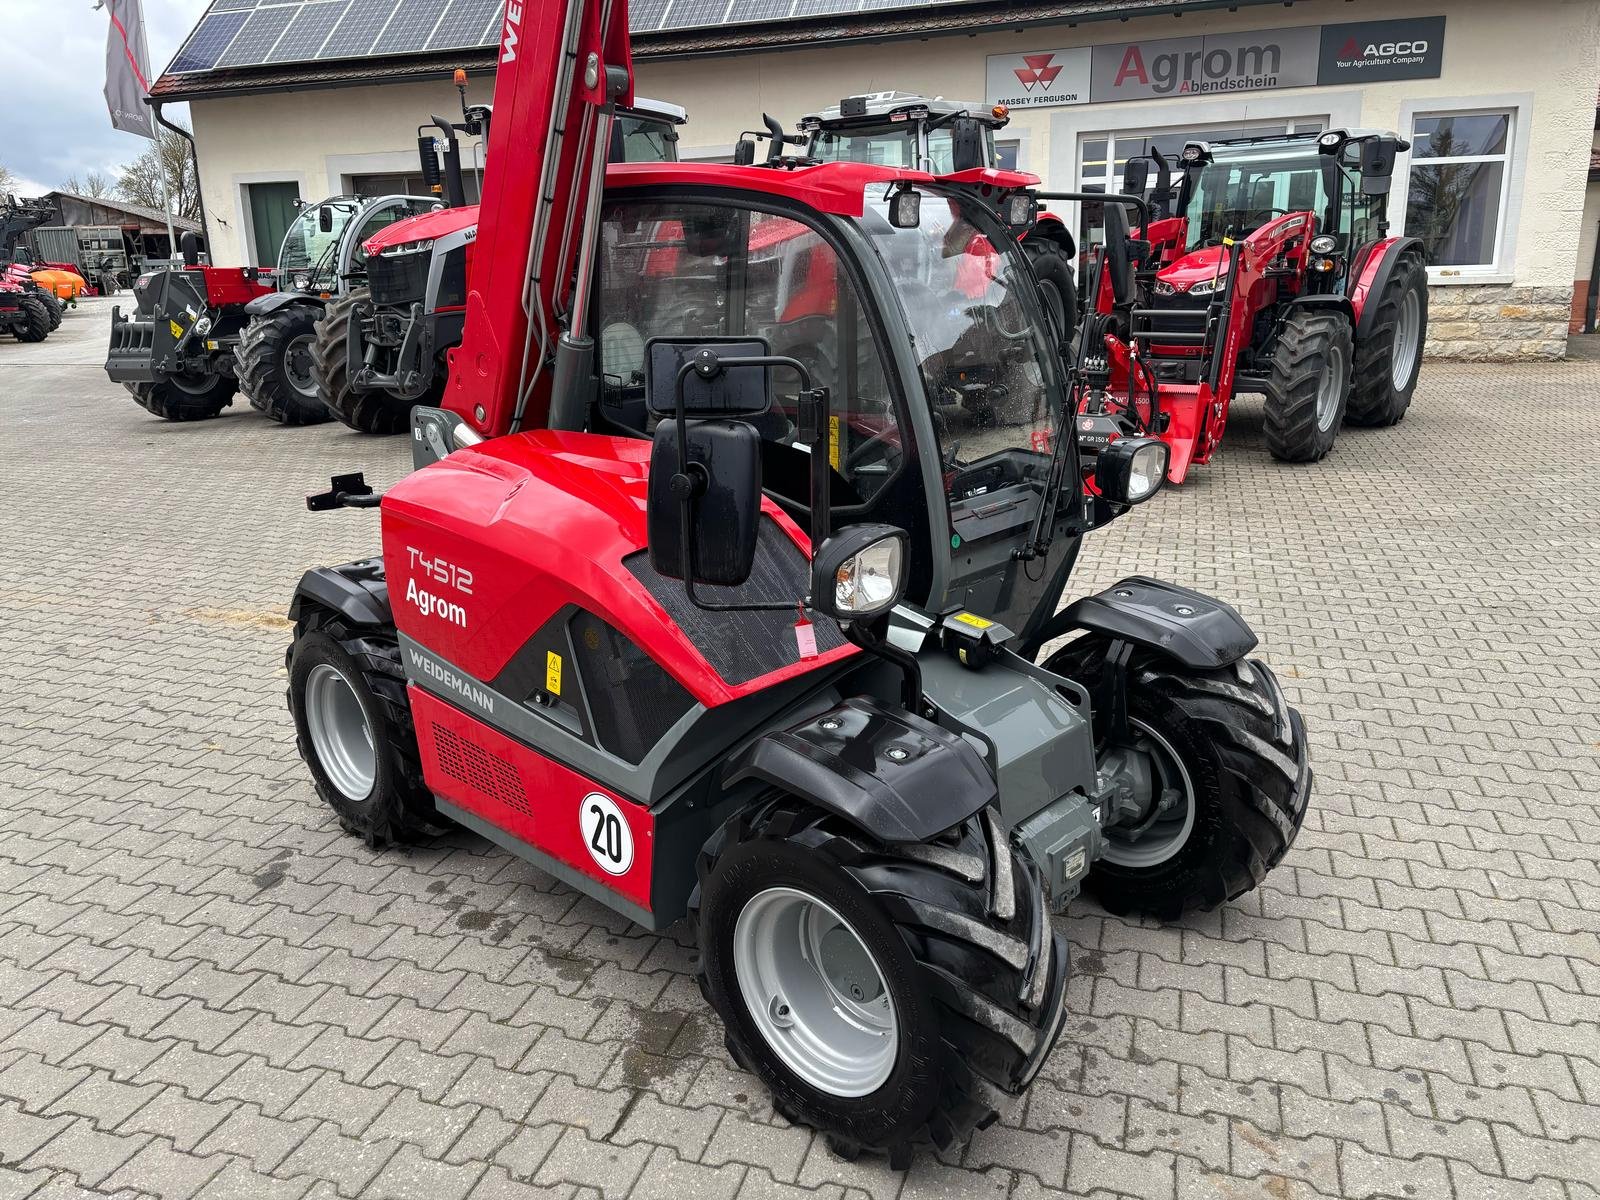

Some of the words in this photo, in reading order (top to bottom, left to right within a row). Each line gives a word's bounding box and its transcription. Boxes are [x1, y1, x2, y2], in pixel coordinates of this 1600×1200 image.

[502, 0, 523, 64] WE
[1363, 40, 1428, 57] AGCO
[1114, 44, 1281, 93] Agrom
[1179, 74, 1277, 94] Abendschein
[1336, 60, 1351, 68] Your
[1352, 58, 1391, 68] Agriculture
[1392, 56, 1425, 64] Company
[998, 97, 1031, 106] MASSEY
[1034, 94, 1078, 103] FERGUSON
[406, 545, 473, 595] T4512
[406, 577, 467, 628] Agrom
[409, 648, 494, 714] WEIDEMANN
[590, 804, 622, 864] 20
